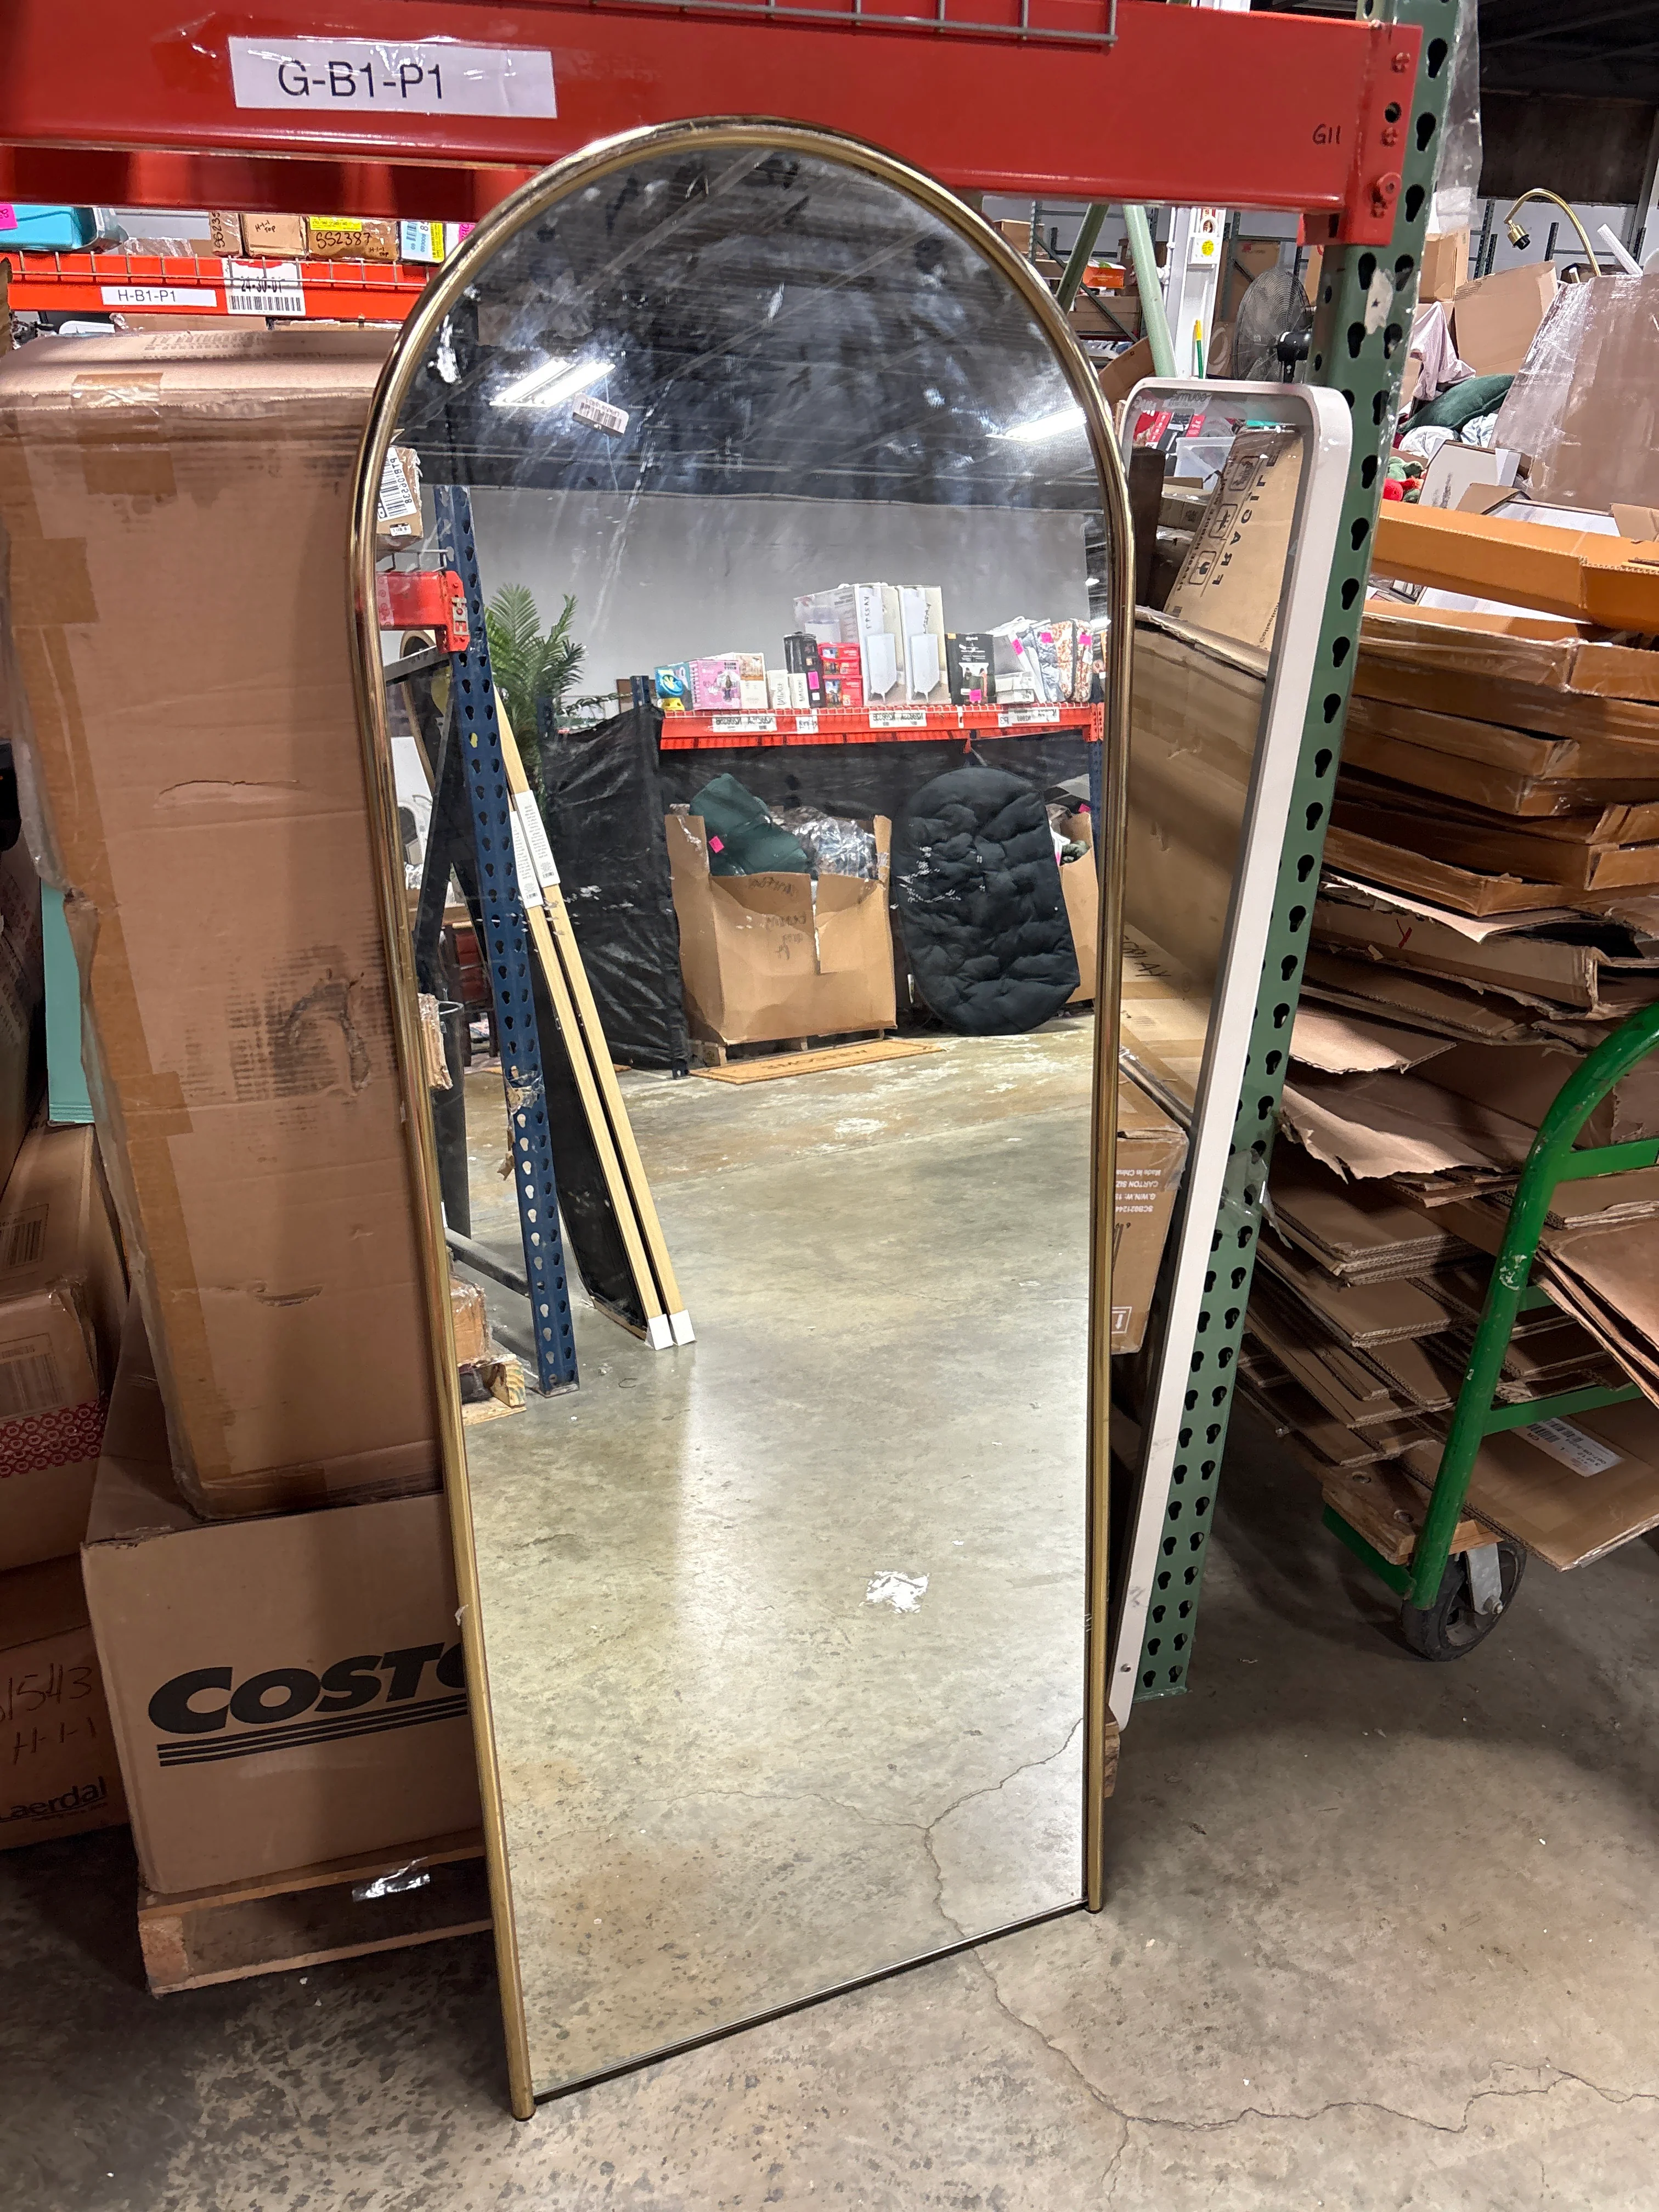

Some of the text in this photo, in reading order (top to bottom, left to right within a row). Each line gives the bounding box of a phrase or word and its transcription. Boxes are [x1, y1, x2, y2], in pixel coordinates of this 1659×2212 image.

[278, 60, 444, 100] G-B1-P1
[117, 289, 177, 303] H-B1-P1
[0, 1662, 93, 1723] 1543
[0, 1775, 108, 1821] aerdal
